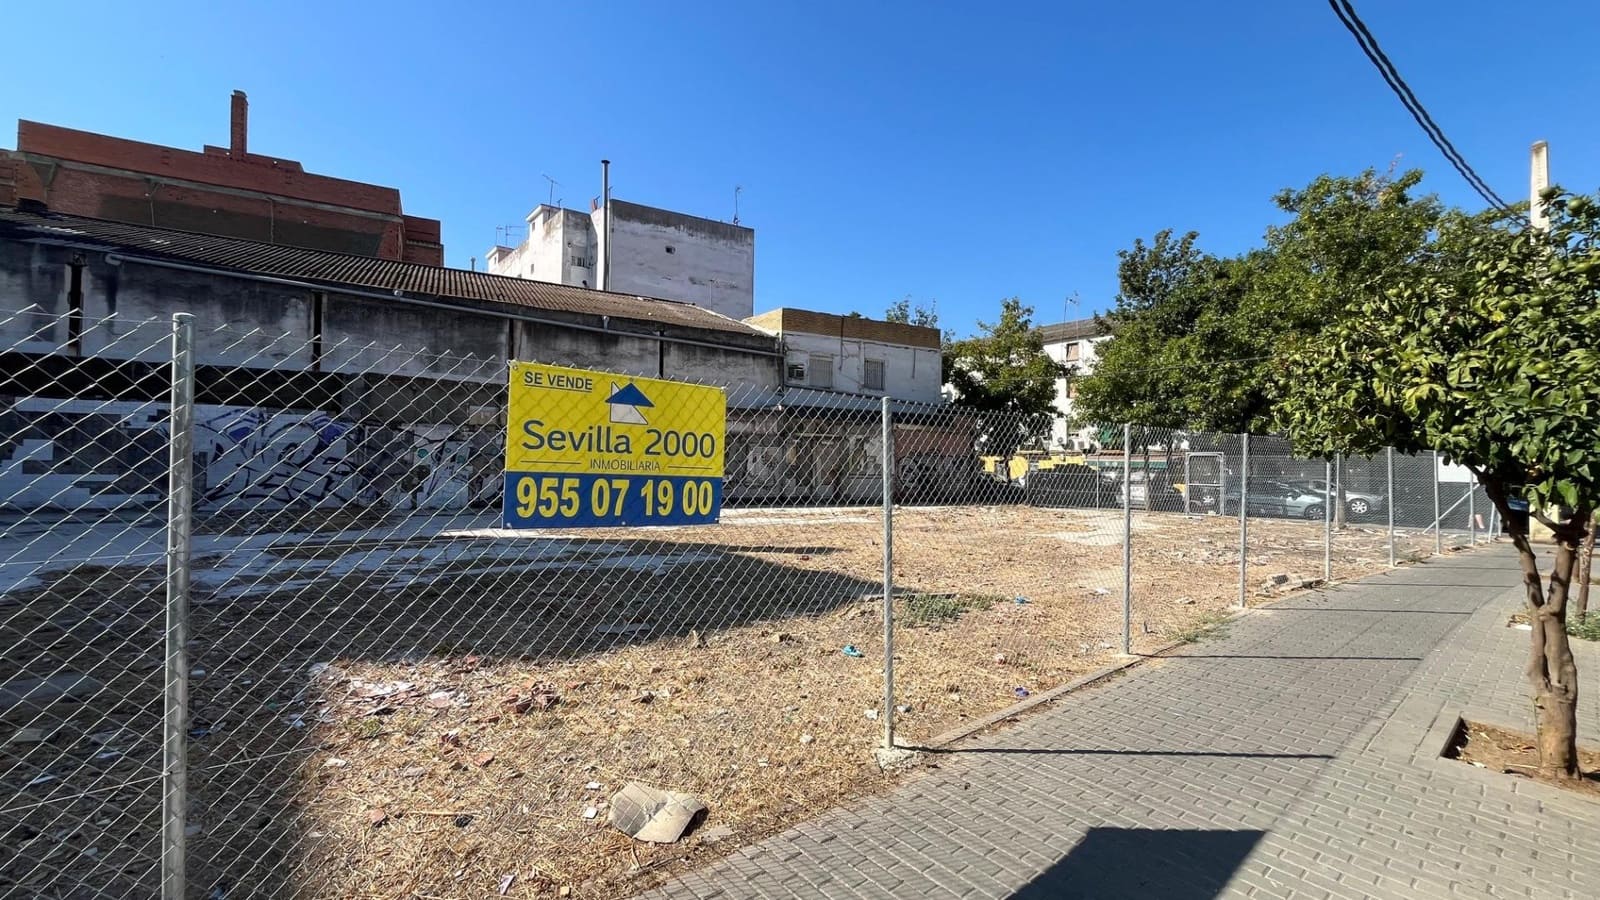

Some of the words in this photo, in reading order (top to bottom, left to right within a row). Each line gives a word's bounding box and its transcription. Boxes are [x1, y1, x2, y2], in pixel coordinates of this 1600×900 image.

[524, 371, 543, 385] SE
[547, 374, 593, 391] VENDE
[522, 419, 632, 454] Sevilla
[645, 429, 715, 458] 2000
[590, 459, 661, 472] INMOBILIARIA
[516, 476, 580, 518] 955
[591, 478, 630, 517] 07
[641, 479, 674, 516] 19
[682, 480, 713, 516] 00
